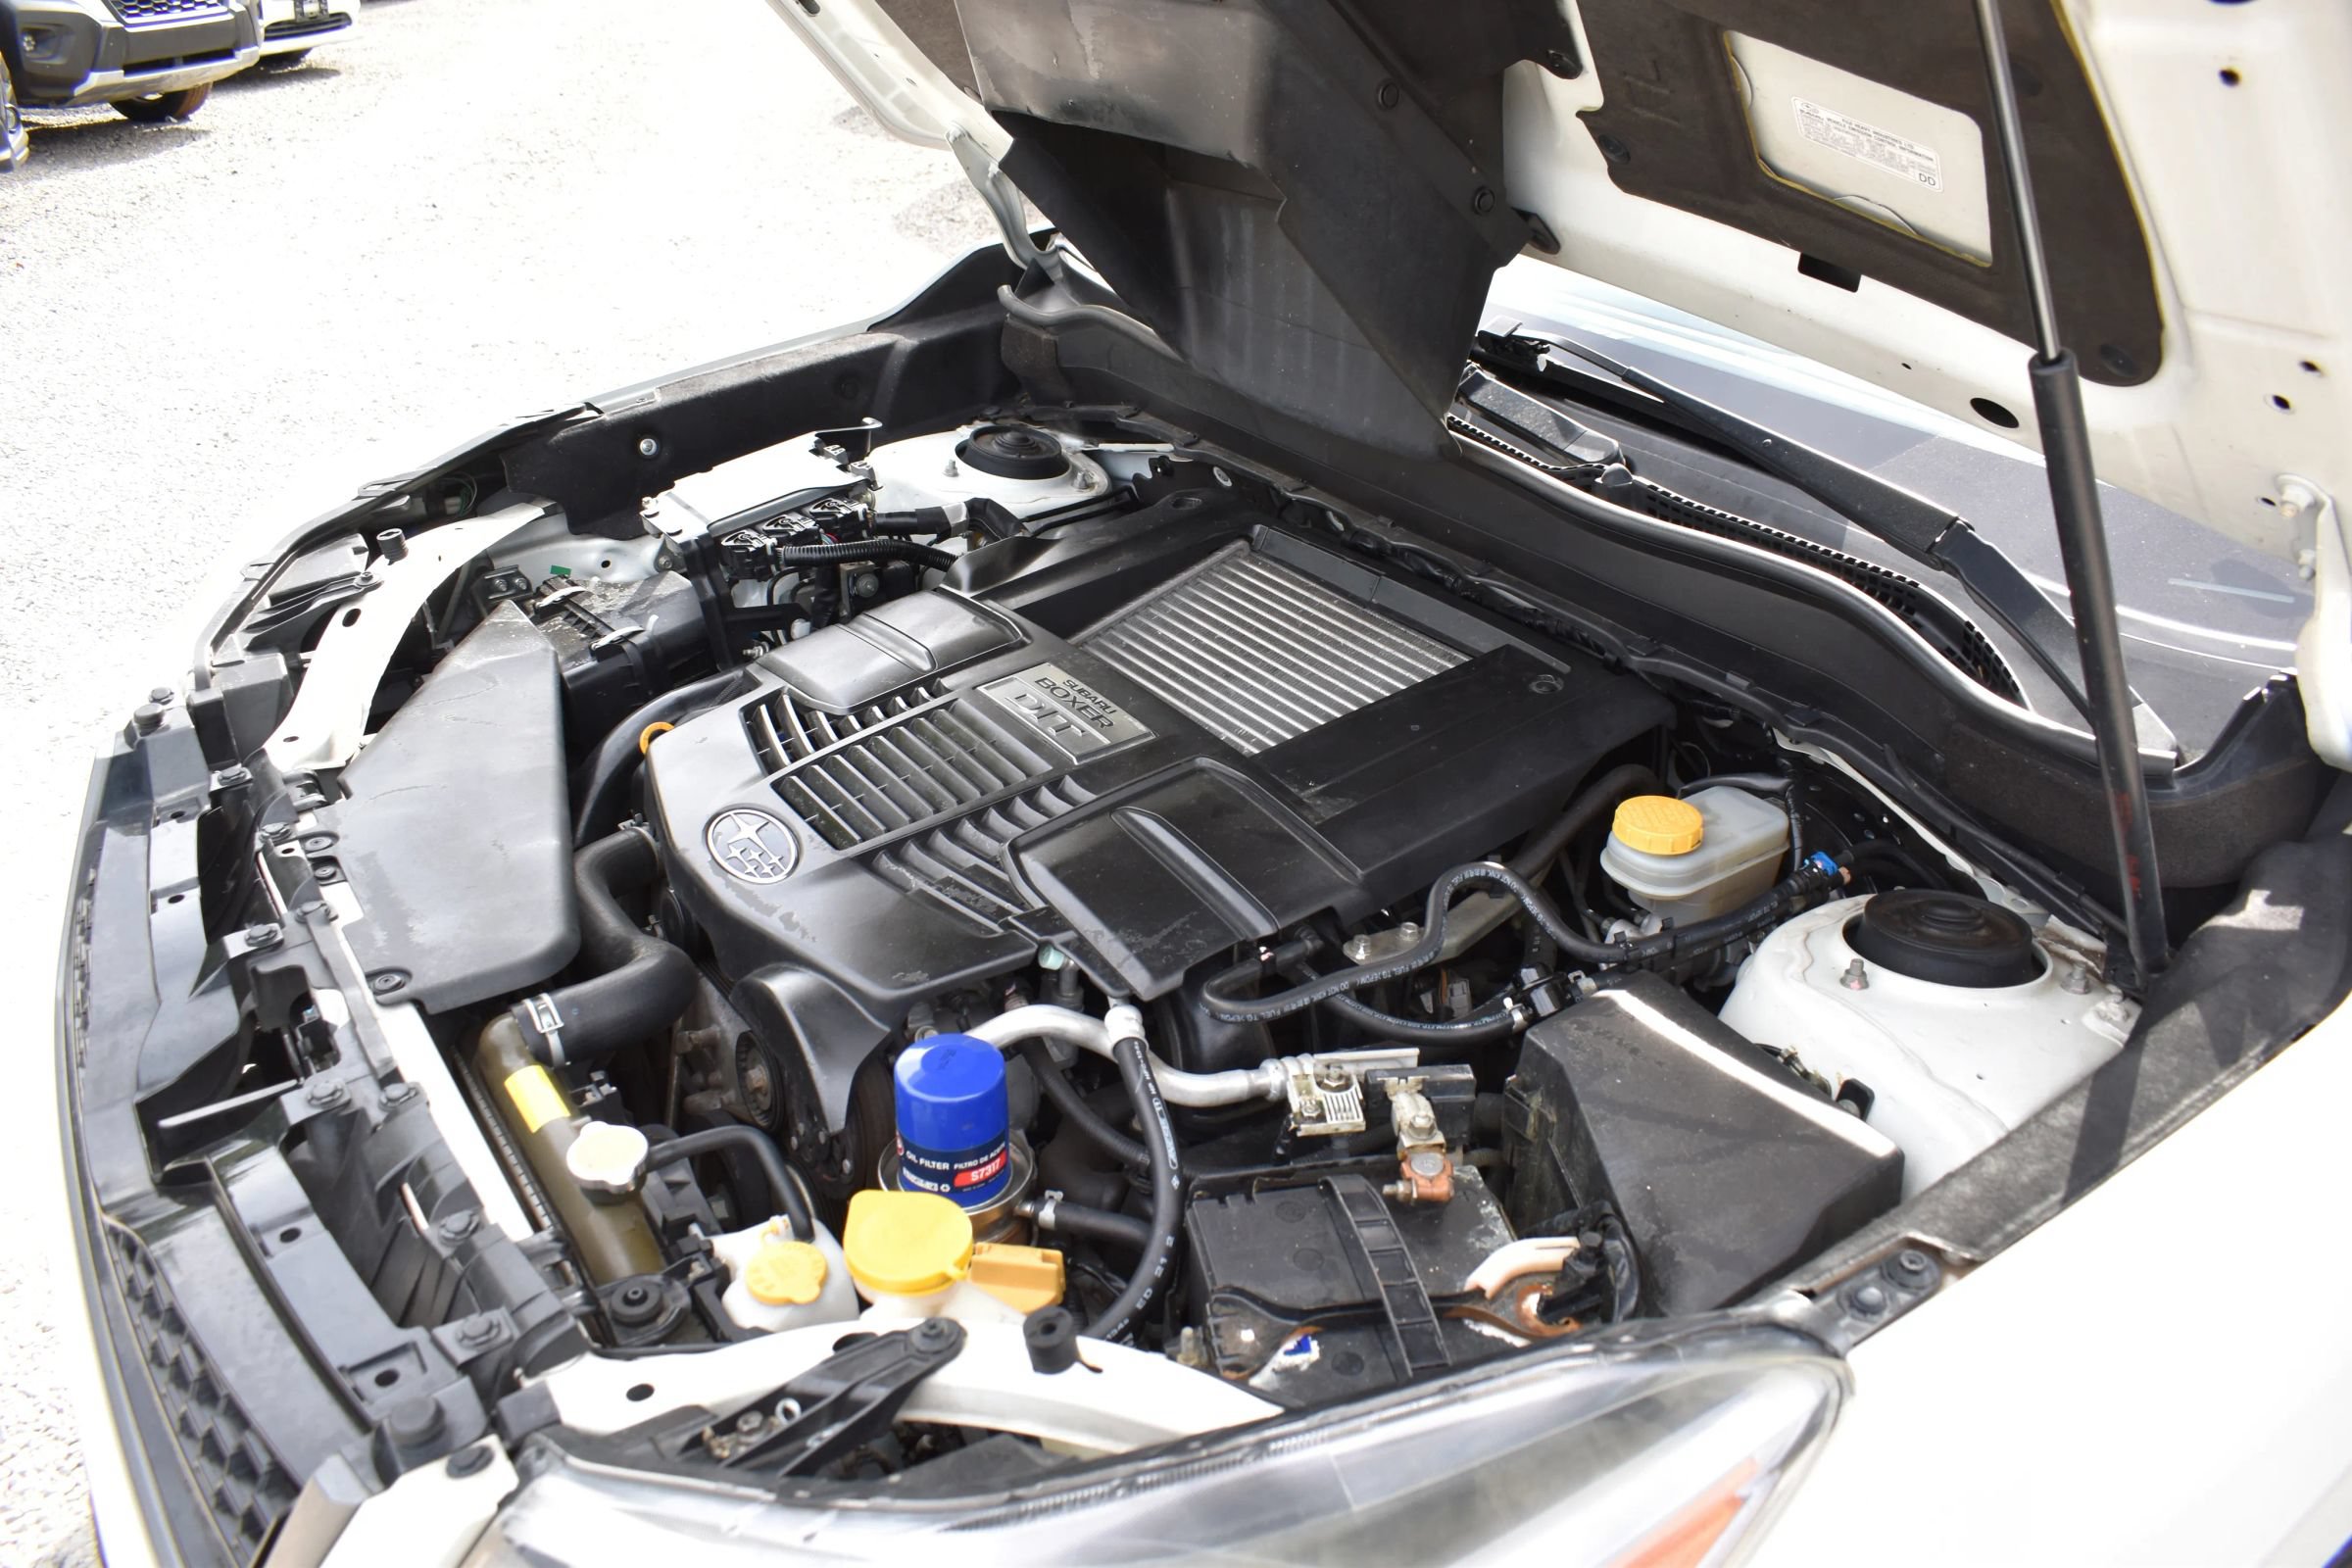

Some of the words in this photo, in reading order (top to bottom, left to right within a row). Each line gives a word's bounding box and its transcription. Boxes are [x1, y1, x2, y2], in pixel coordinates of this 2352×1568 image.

[1919, 172, 1936, 186] DD
[1034, 677, 1114, 729] BOXER
[1062, 679, 1117, 714] SUBARU
[1004, 693, 1086, 737] DIT
[906, 1150, 918, 1164] OIL
[919, 1157, 950, 1170] FILTER
[954, 1159, 978, 1170] FILTRO
[979, 1154, 989, 1163] DE
[970, 1157, 1002, 1182] S7317
